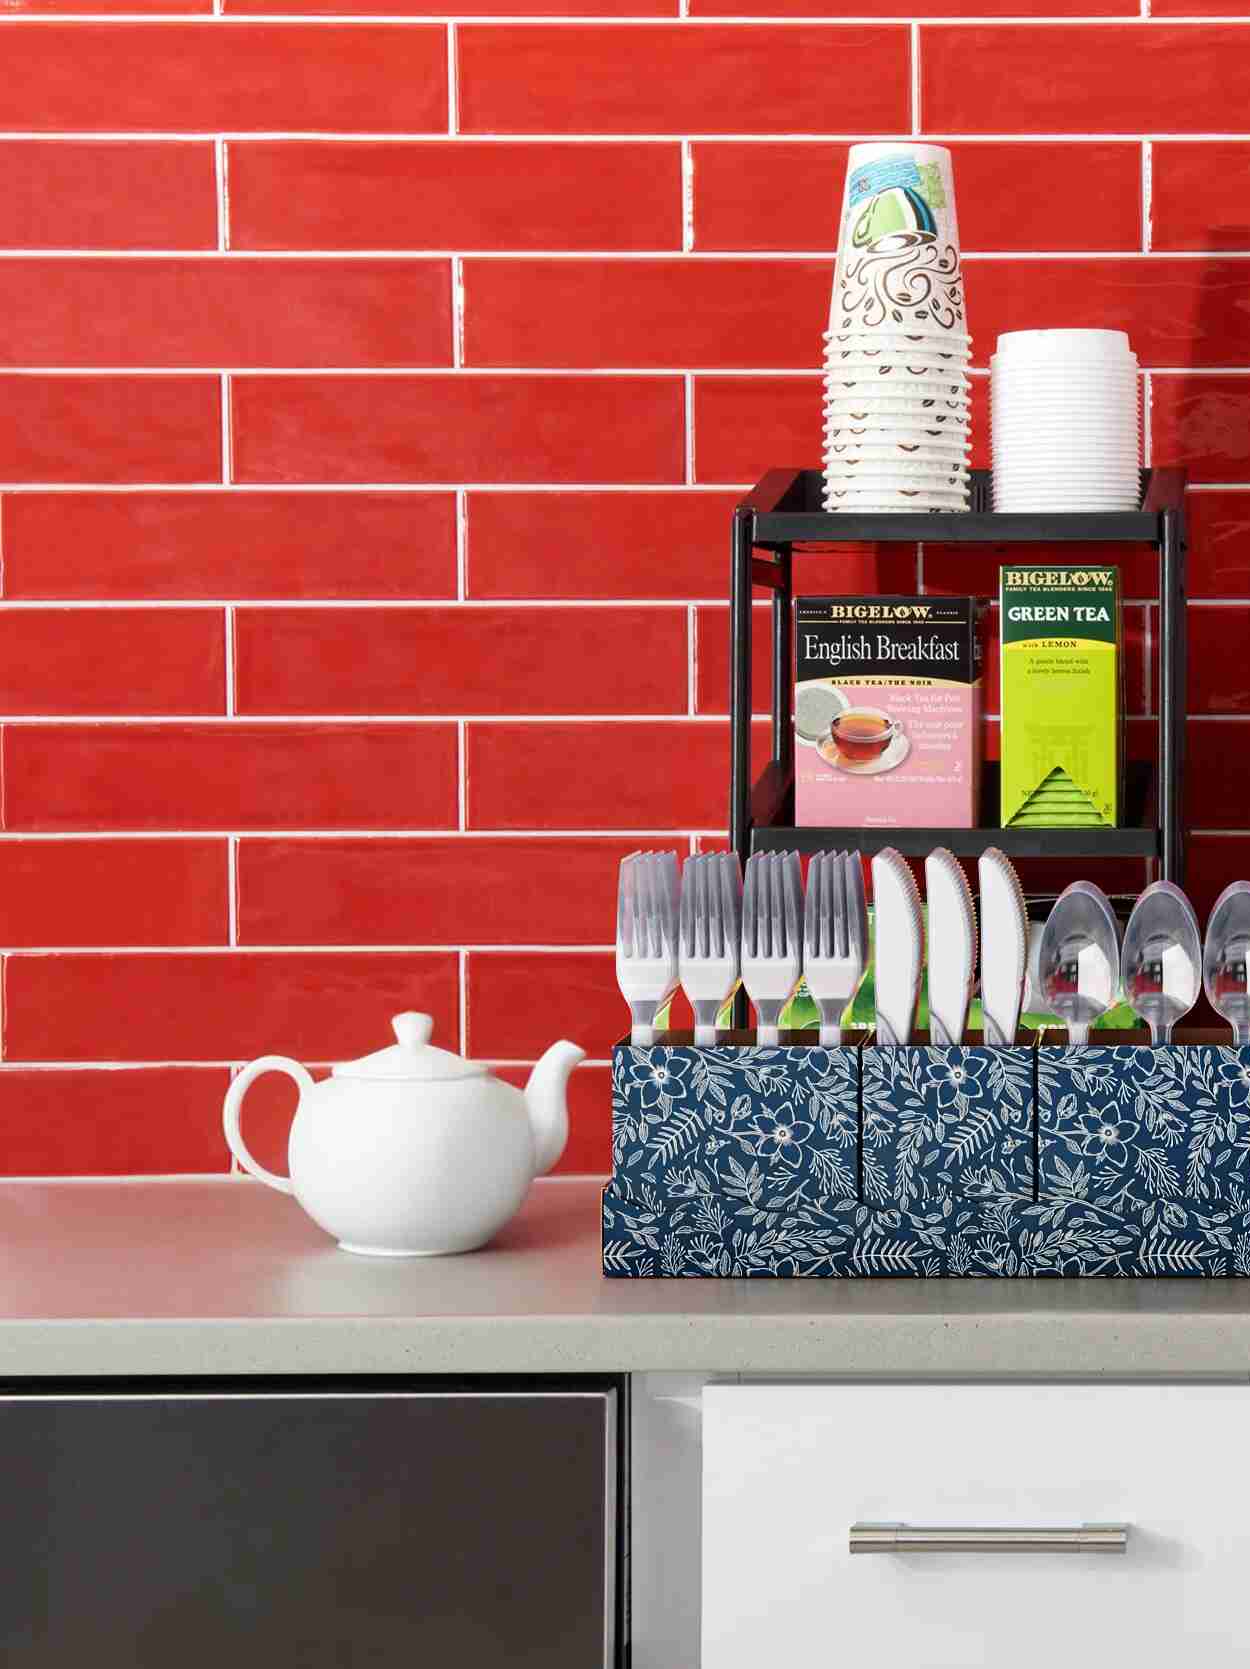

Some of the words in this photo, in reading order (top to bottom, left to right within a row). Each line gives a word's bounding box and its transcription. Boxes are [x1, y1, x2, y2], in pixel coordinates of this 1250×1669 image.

[1006, 571, 1113, 586] BIGELOW
[831, 605, 932, 619] BIGELOW
[1008, 606, 1069, 621] GREEN
[1073, 606, 1110, 621] TEA
[804, 634, 872, 665] English
[876, 634, 960, 661] Breakfast
[1041, 640, 1077, 648] LEMON
